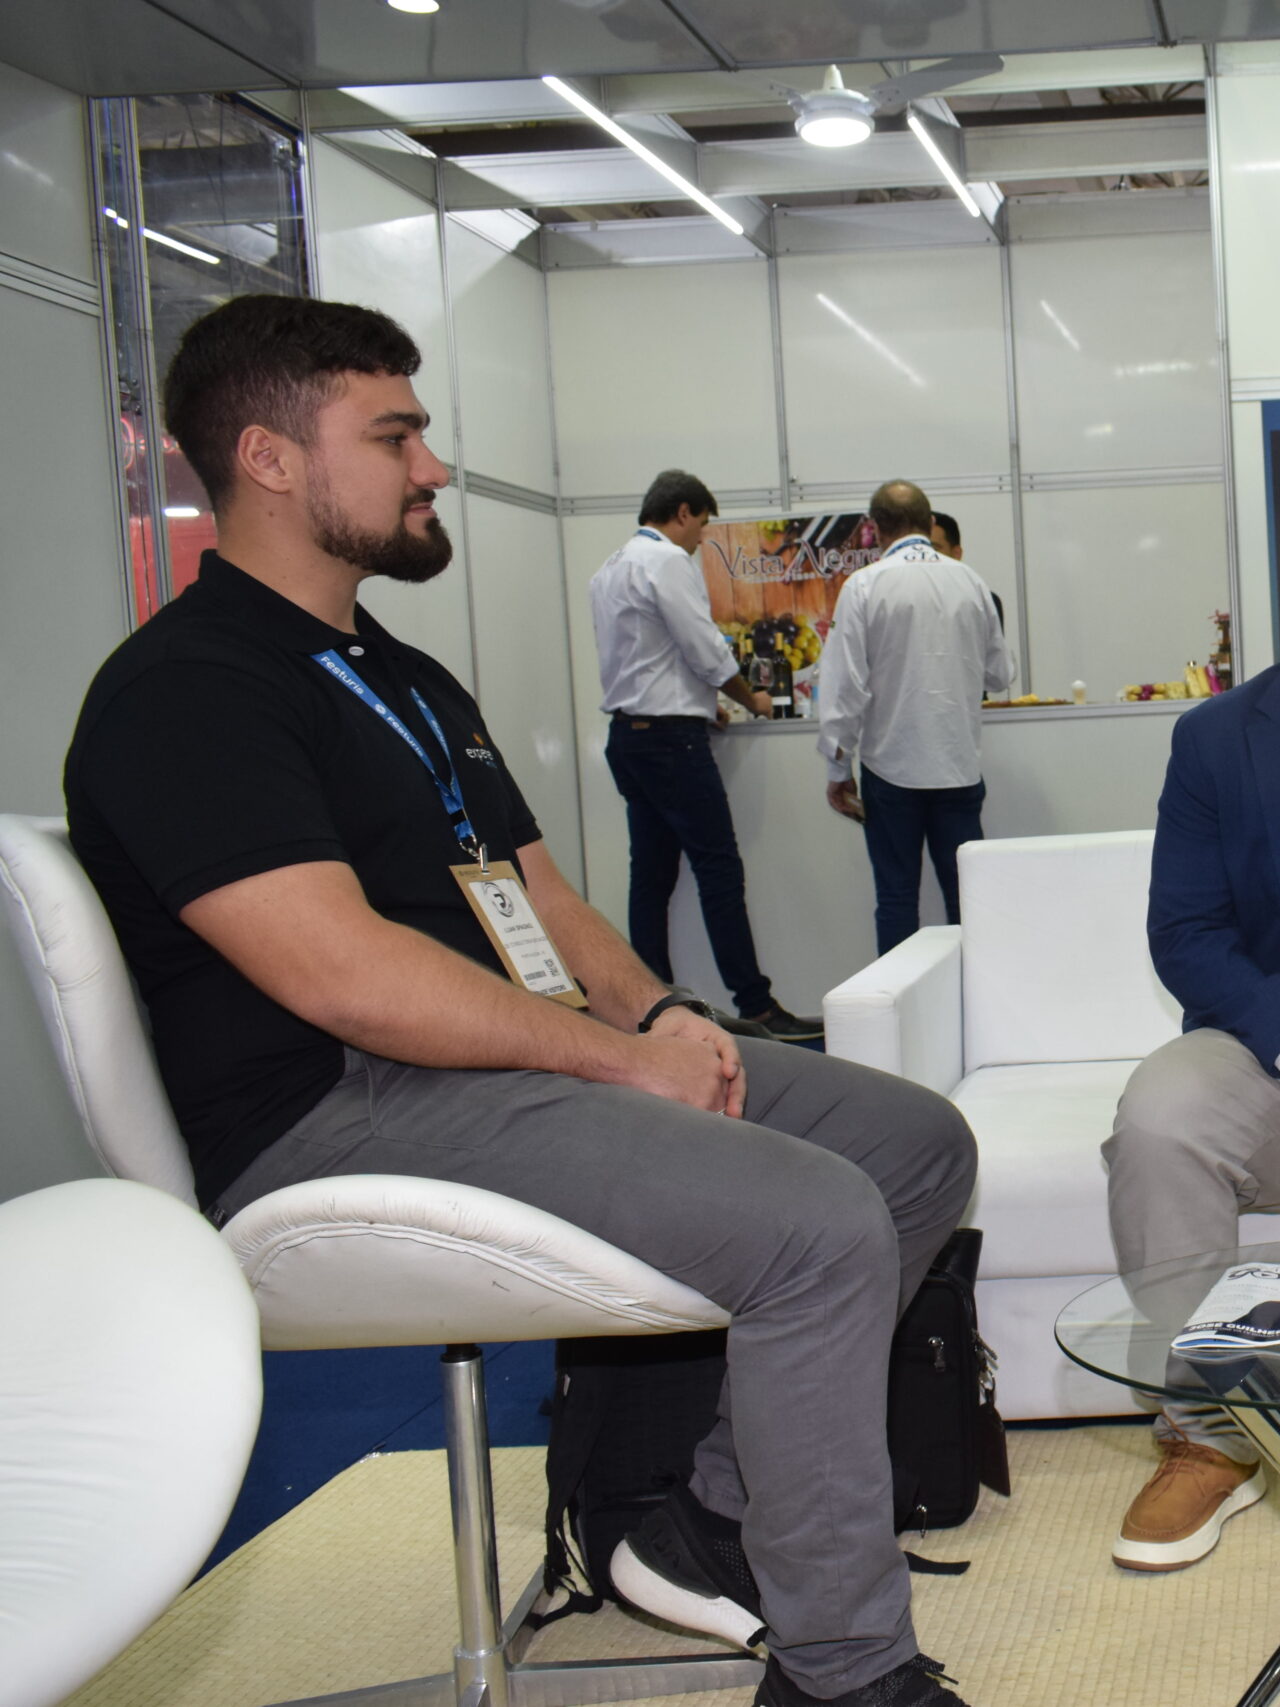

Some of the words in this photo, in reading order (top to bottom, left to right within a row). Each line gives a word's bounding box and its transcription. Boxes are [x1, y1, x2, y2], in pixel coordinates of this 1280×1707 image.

[707, 539, 784, 577] Vista
[320, 655, 365, 695] Festuris
[386, 715, 424, 758] Festuris
